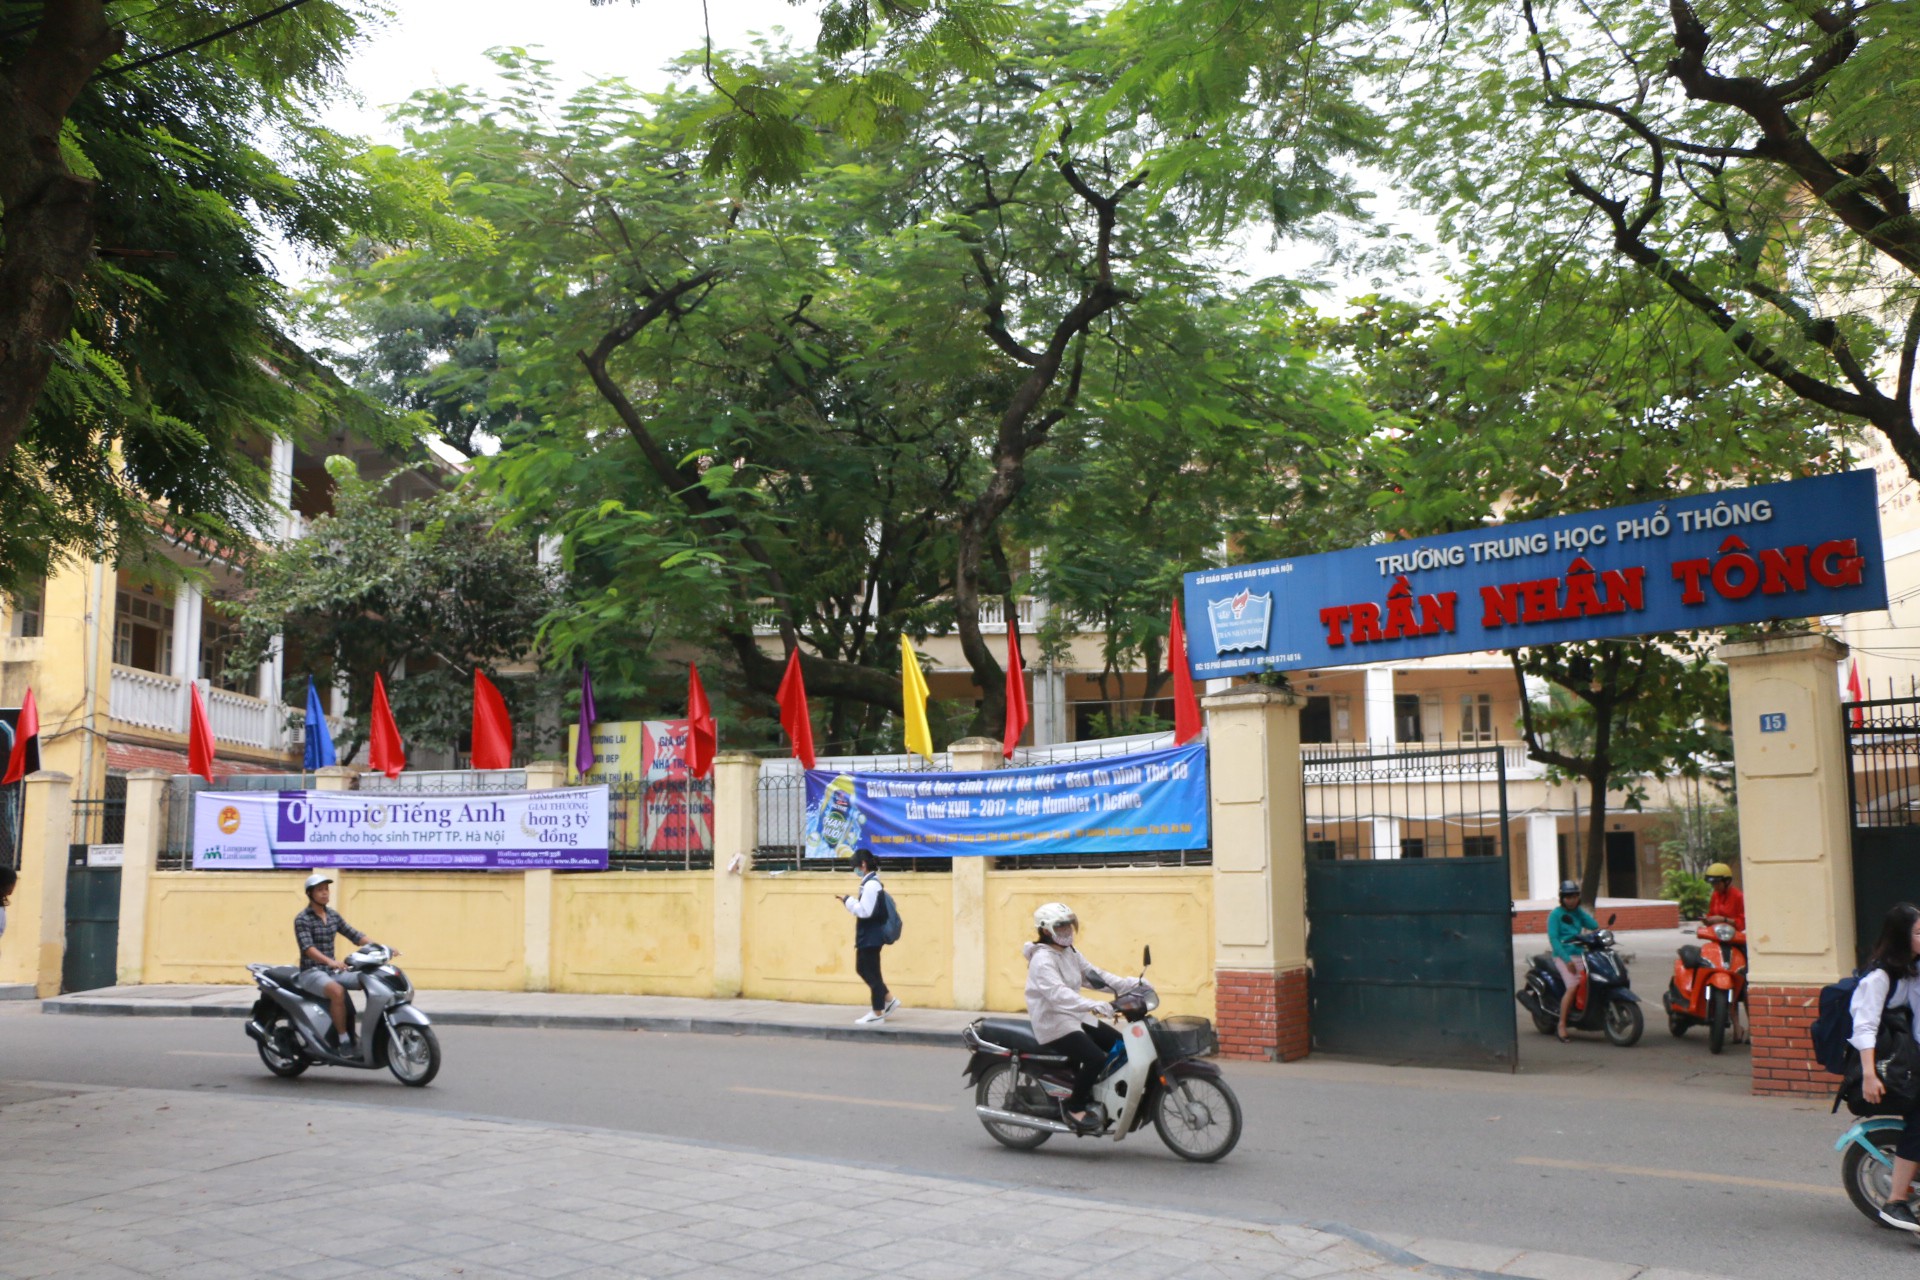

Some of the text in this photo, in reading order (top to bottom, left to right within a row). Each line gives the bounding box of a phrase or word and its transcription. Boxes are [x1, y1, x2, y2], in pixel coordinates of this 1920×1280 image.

[1375, 500, 1773, 576] TRƯỜNG TRUNG HỌC PHỔ THÔNG
[1206, 574, 1220, 583] GIÁO
[1221, 573, 1234, 582] DỤC
[1235, 570, 1243, 579] VÀ
[1244, 569, 1256, 578] ĐÀO
[1258, 568, 1270, 577] TẠO
[1270, 565, 1280, 574] HÀ
[1281, 563, 1293, 573] NỘI
[1319, 534, 1865, 646] TRẦN NHÂN TÔNG
[1765, 715, 1781, 730] 15
[866, 780, 888, 798] Giải
[888, 782, 916, 799] bóng
[917, 781, 932, 796] đá
[933, 780, 956, 798] học
[958, 779, 983, 794] sinh
[986, 777, 1014, 793] THPT
[1016, 775, 1032, 792] Hà
[1034, 773, 1055, 793] Nội
[1065, 771, 1090, 789] Báo
[1093, 769, 1110, 786] An
[1112, 766, 1142, 785] ninh
[1144, 761, 1168, 781] Thủ
[286, 800, 506, 828] Olympic Tiếng Anh
[905, 800, 925, 820] Lần
[926, 801, 946, 819] thứ
[948, 800, 970, 818] XVII
[980, 799, 1006, 817] 2017
[1016, 796, 1039, 817] Cúp
[1042, 794, 1090, 814] Number
[1093, 793, 1100, 812] 1
[1103, 791, 1142, 811] Active
[528, 811, 590, 828] hơn 3 tỷ
[309, 830, 505, 845] dành cho học sinh THPT TP. Hà Nội
[539, 828, 578, 846] đồng
